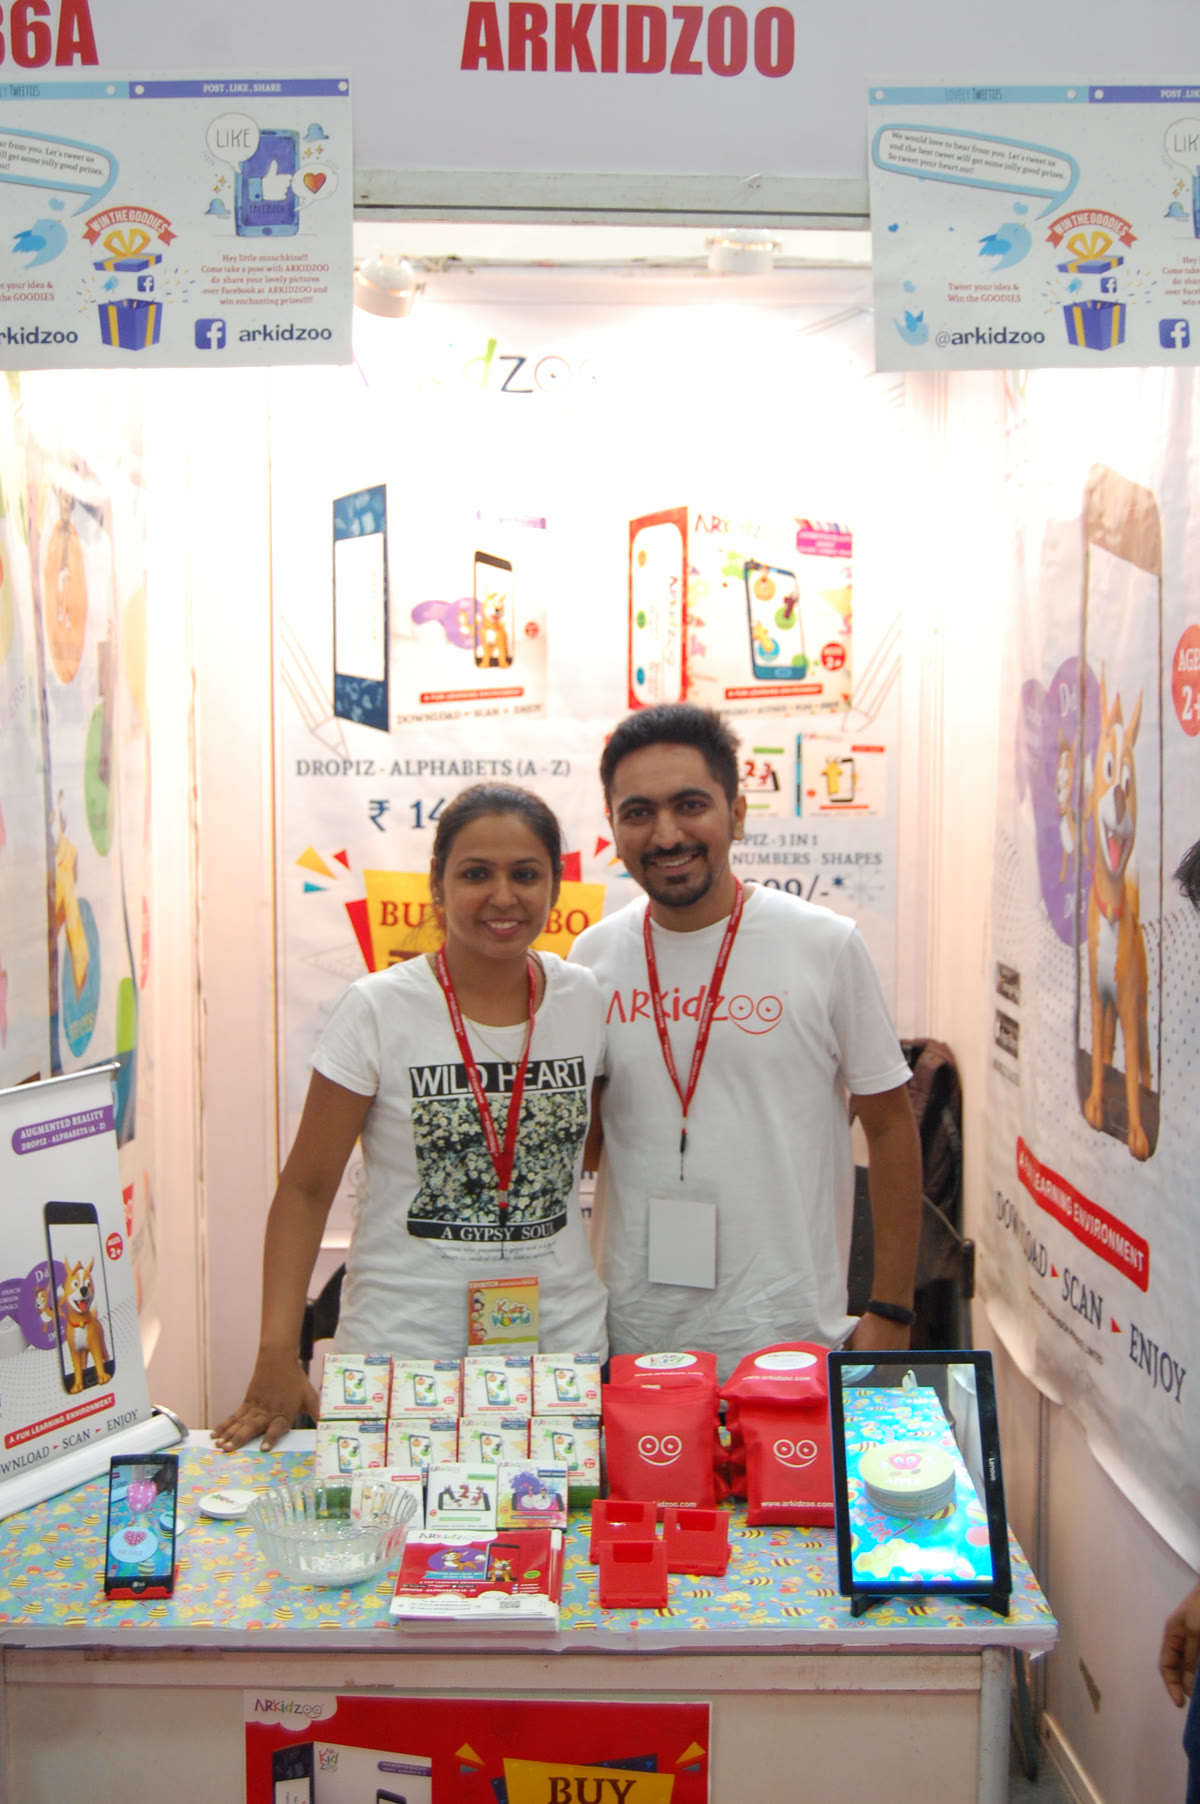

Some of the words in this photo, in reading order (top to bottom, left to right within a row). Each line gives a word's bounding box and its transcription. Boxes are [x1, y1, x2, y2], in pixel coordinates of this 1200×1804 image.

[460, 1, 796, 77] ARKIDZOO
[216, 128, 252, 148] LIKE
[891, 130, 904, 139] We
[904, 134, 928, 144] would
[929, 138, 943, 147] love
[954, 142, 970, 152] hear
[972, 144, 990, 155] from
[1008, 152, 1025, 162] Let's
[1026, 156, 1046, 166] tweet
[888, 152, 897, 160] So
[898, 155, 918, 165] tweet
[920, 159, 937, 168] your
[889, 142, 904, 152] and
[904, 144, 917, 154] the
[918, 146, 934, 157] best
[934, 150, 955, 160] tweet
[956, 153, 970, 162] will
[972, 156, 984, 166] get
[984, 159, 1003, 168] some
[1004, 162, 1021, 174] jolly
[1022, 165, 1040, 176] good
[90, 212, 111, 232] WIN
[111, 209, 128, 222] THE
[128, 210, 169, 234] GOODIES
[1054, 216, 1073, 233] WIN
[1072, 212, 1090, 226] THE
[1090, 212, 1130, 236] GOODIES
[201, 265, 222, 273] Come
[224, 264, 240, 272] take
[266, 264, 284, 272] with
[285, 264, 330, 272] ARKIDZOO
[222, 254, 238, 263] Hey
[7, 282, 25, 291] your
[27, 281, 45, 290] idea
[264, 276, 288, 284] lovely
[288, 275, 320, 284] pictures
[948, 282, 972, 291] Tweet
[974, 284, 992, 293] your
[994, 282, 1012, 291] idea
[13, 293, 55, 302] GOODIES
[220, 286, 256, 294] Facebook
[268, 286, 312, 294] ARKIDZOO
[947, 294, 965, 302] Win
[966, 294, 980, 302] the
[980, 294, 1022, 302] GOODIES
[235, 297, 279, 306] enchanting
[238, 323, 332, 342] arkidzoo
[935, 326, 1046, 348] @arkidzoo
[296, 760, 376, 776] DROPIZ
[390, 760, 512, 777] ALPHABETS
[790, 834, 808, 846] IN
[732, 853, 810, 866] NUMBERS
[821, 852, 882, 866] SHAPES
[411, 1064, 489, 1096] WILD
[498, 1058, 582, 1092] HEART
[20, 1116, 72, 1139] AUGMENTED
[72, 1109, 104, 1126] REALITY
[22, 1137, 48, 1151] DROPIZ
[52, 1126, 88, 1144] ALPHABETS
[441, 1226, 452, 1240] A
[460, 1226, 514, 1242] GYPSY
[521, 1221, 556, 1239] SOUL
[1073, 1201, 1146, 1272] ENVIRONMENT
[110, 1247, 122, 1258] 2+
[1062, 1268, 1104, 1330] SCAN
[1130, 1322, 1187, 1404] ENJOY
[8, 1432, 16, 1444] A
[16, 1428, 32, 1441] FUN
[32, 1414, 65, 1434] LEARNING
[65, 1396, 114, 1420] ENVIRONMENT
[62, 1428, 91, 1450] SCAN
[106, 1408, 138, 1432] ENJOY
[988, 1456, 996, 1482] Lenovo
[548, 1776, 637, 1804] BUY
